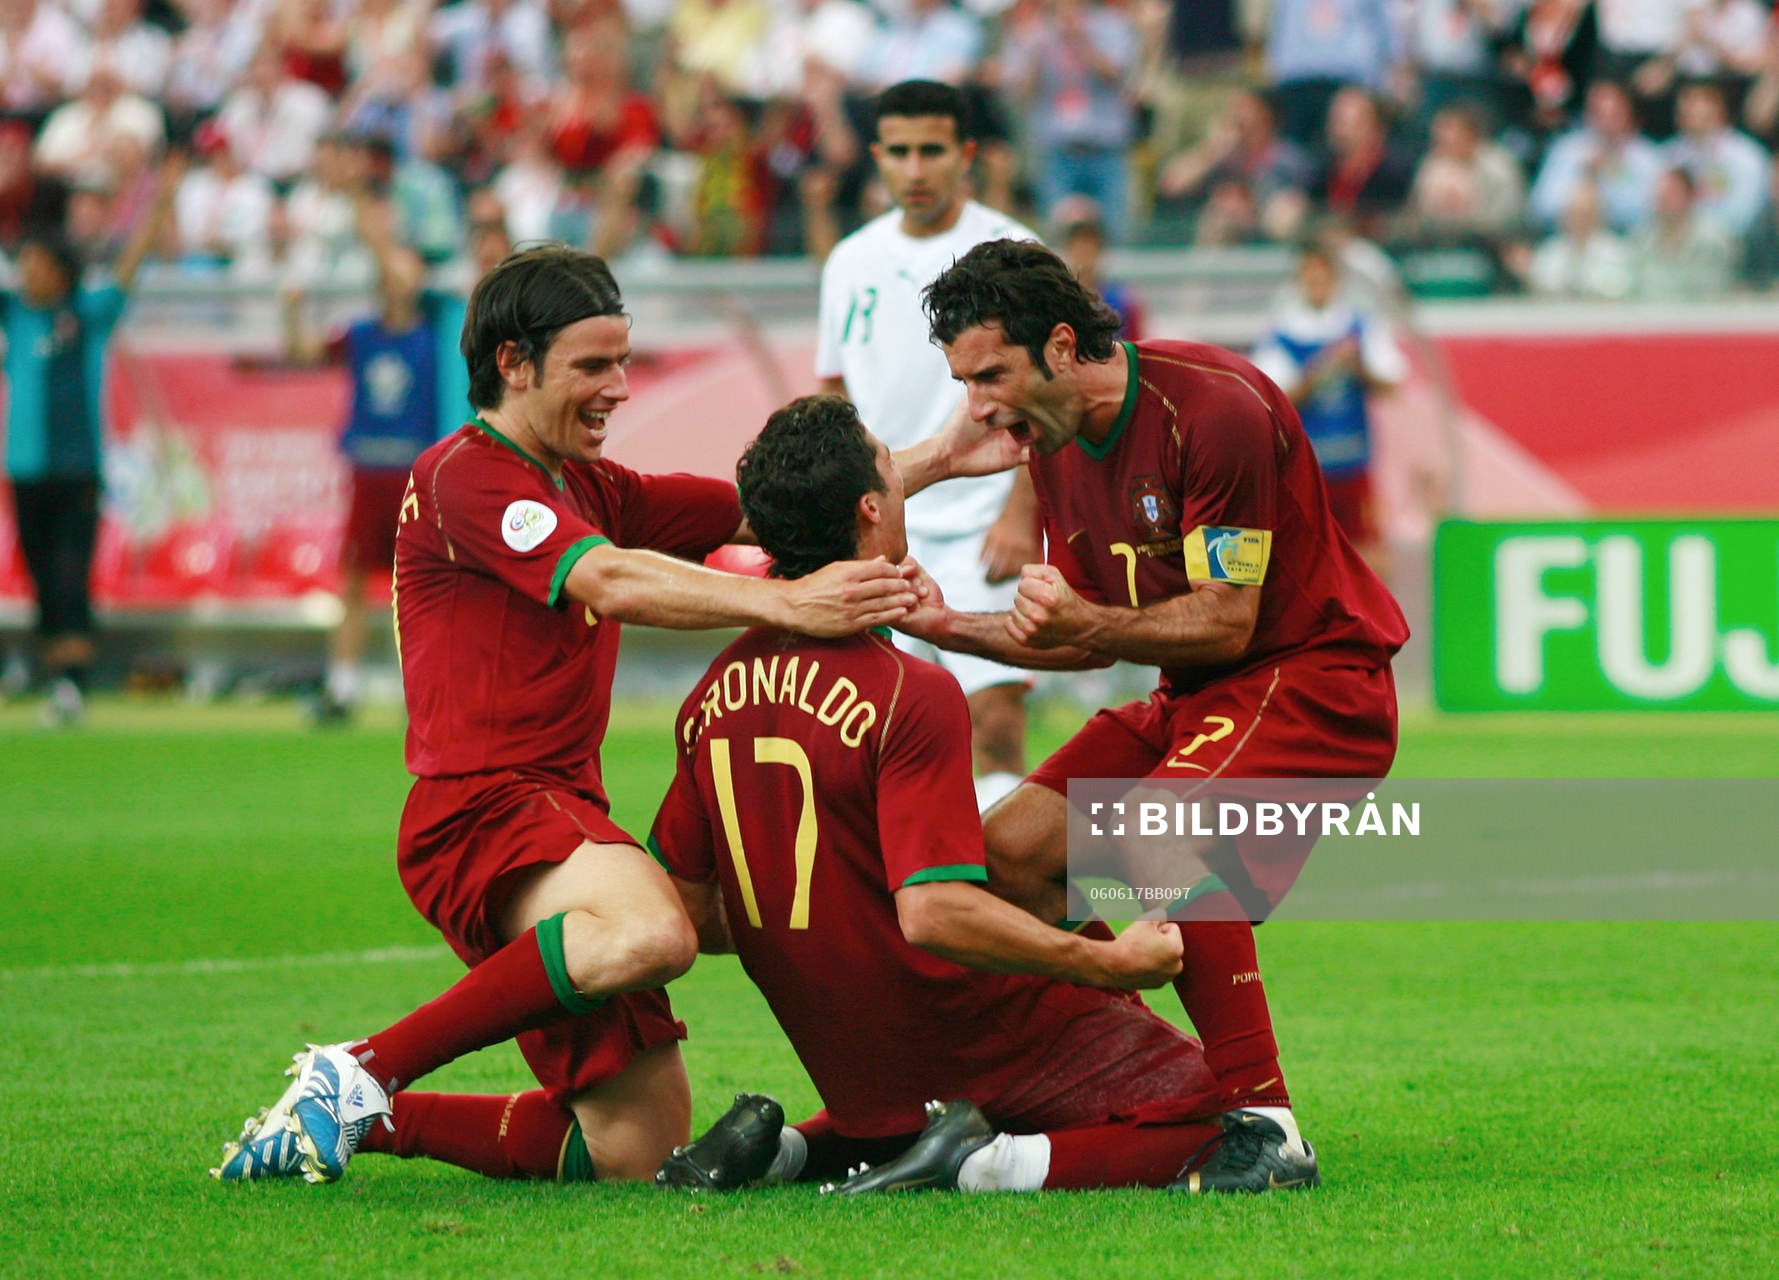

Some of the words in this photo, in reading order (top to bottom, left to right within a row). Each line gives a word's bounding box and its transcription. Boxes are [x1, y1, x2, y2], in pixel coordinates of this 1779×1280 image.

[1110, 542, 1138, 608] 7
[1178, 715, 1235, 756] 7
[710, 736, 819, 930] 17
